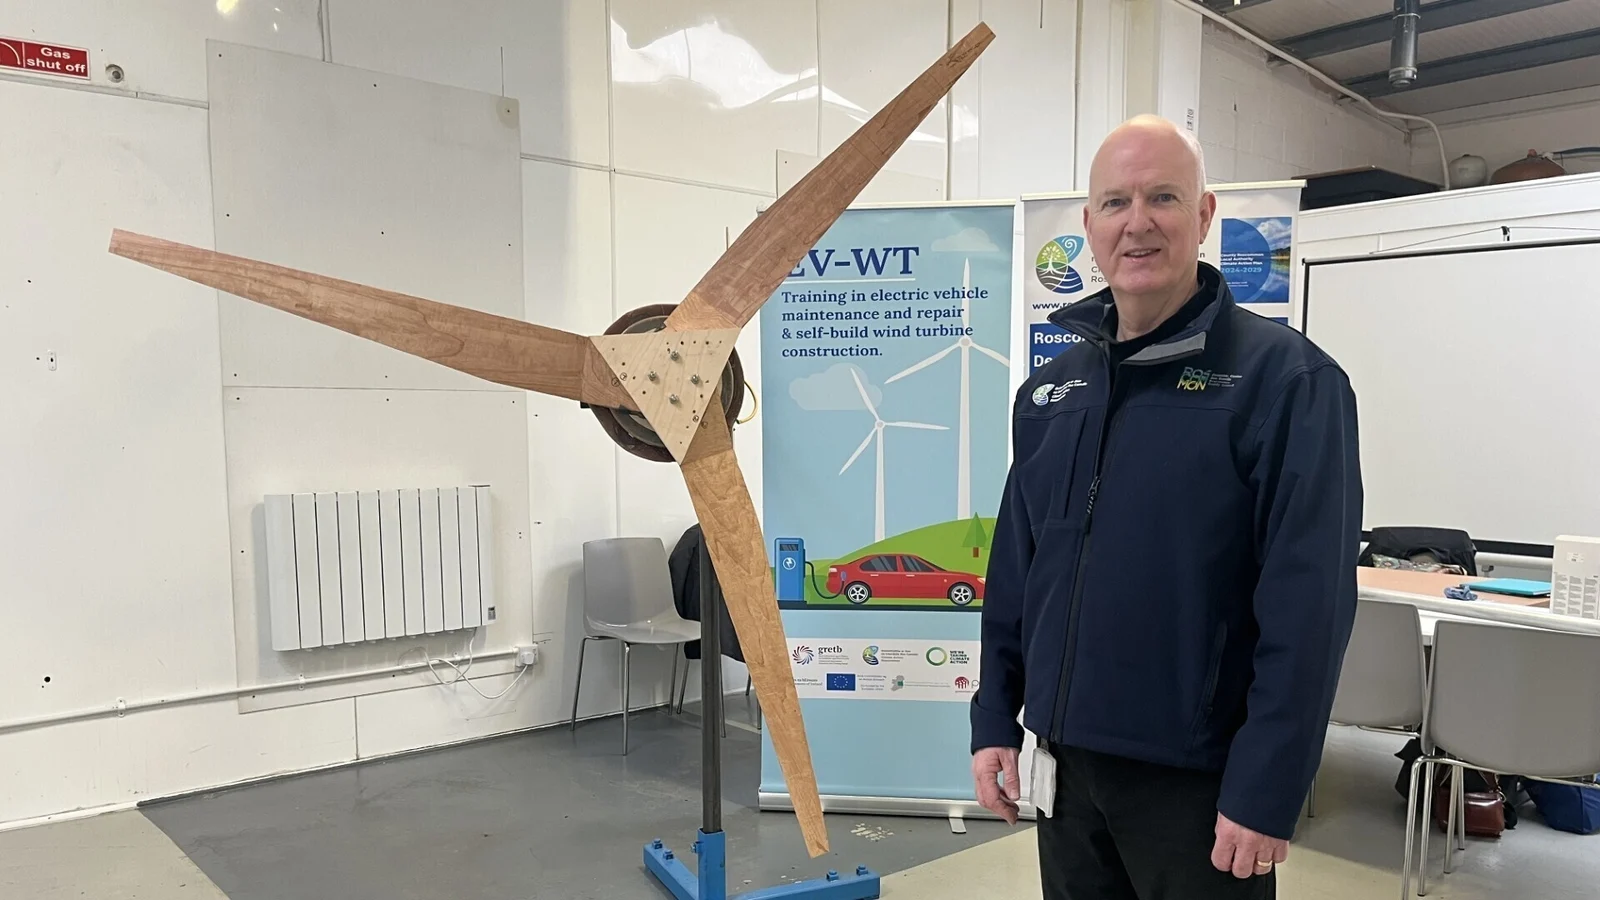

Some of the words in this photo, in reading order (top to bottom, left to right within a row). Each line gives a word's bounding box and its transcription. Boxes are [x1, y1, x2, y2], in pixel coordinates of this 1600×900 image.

[41, 47, 70, 59] Gas
[26, 58, 61, 70] shut
[65, 63, 86, 73] off
[781, 290, 847, 306] Training
[851, 289, 866, 302] in
[870, 288, 929, 301] electric
[933, 286, 989, 300] vehicle
[782, 309, 880, 321] maintenance
[884, 307, 912, 320] and
[917, 305, 965, 321] repair
[782, 328, 792, 340] &
[796, 326, 869, 339] self-build
[873, 325, 911, 338] wind
[915, 324, 974, 337] turbine
[1034, 332, 1085, 344] Rosco
[782, 344, 883, 357] construction.
[1176, 380, 1206, 391] MON
[818, 645, 843, 654] gretb
